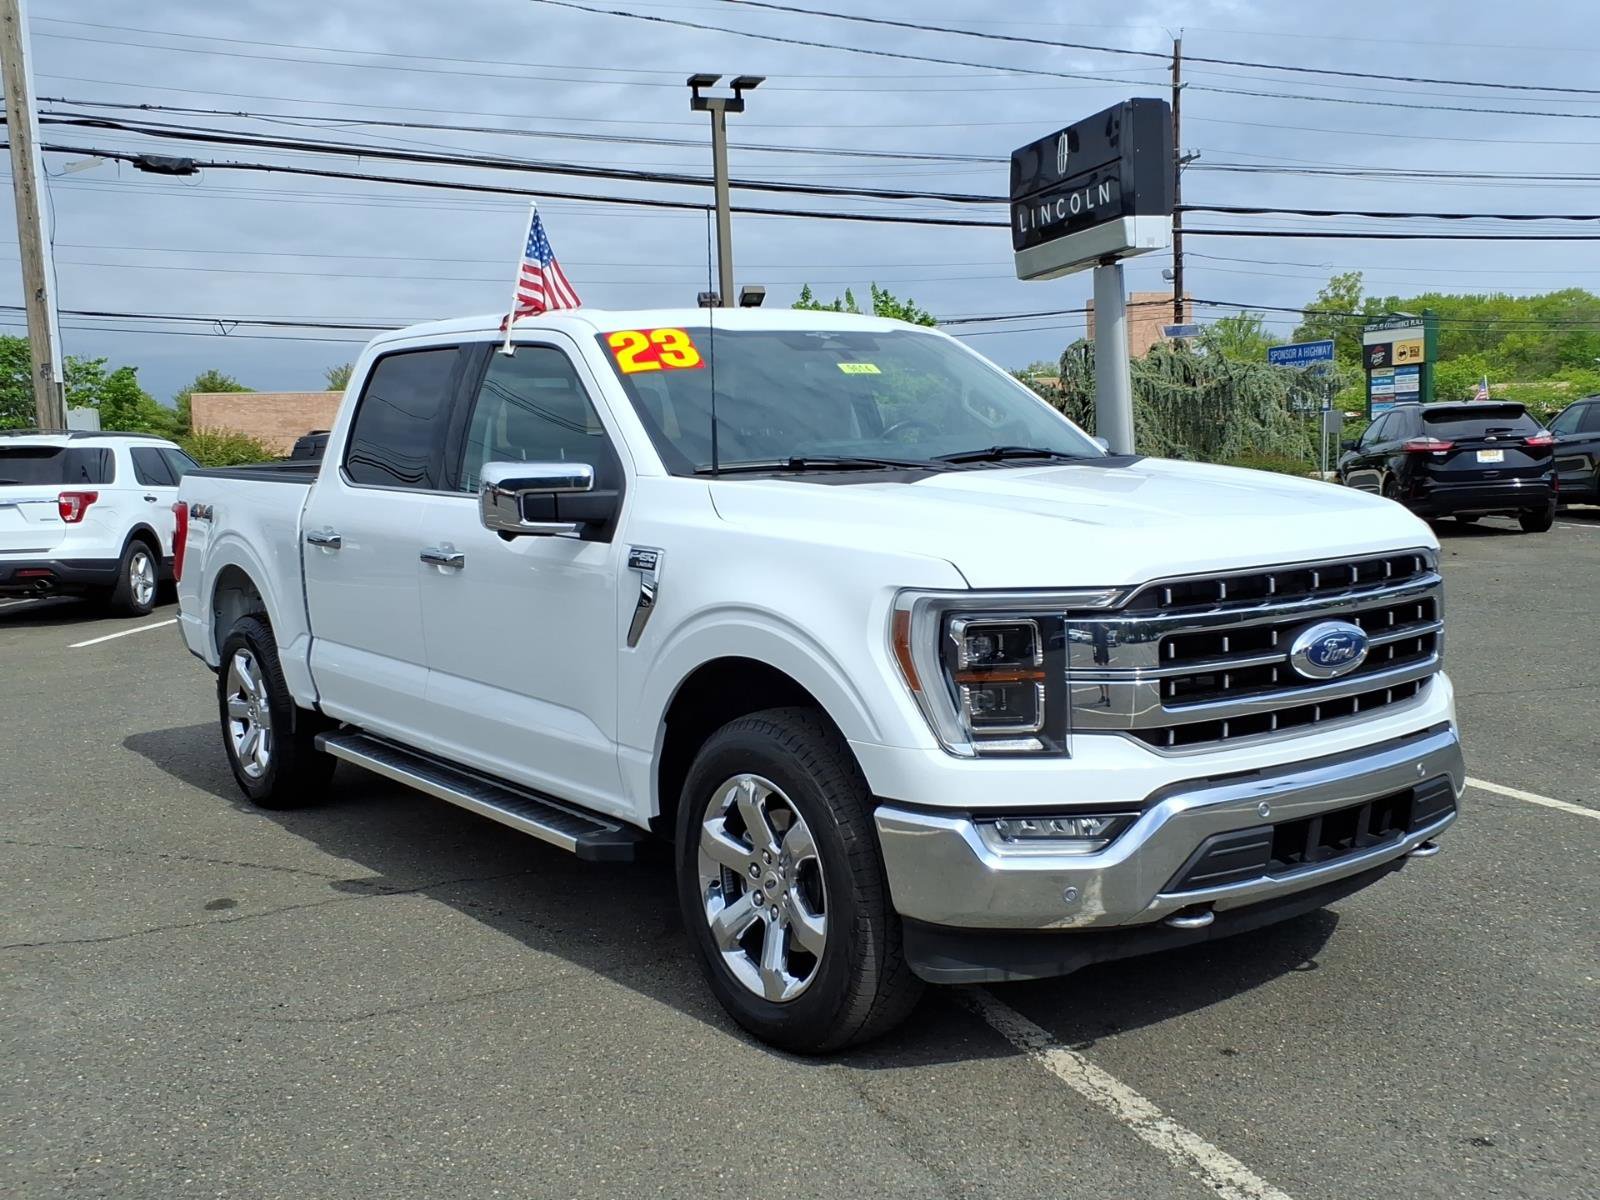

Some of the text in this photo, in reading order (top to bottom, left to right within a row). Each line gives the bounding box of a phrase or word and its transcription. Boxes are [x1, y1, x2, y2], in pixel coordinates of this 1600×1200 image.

[1019, 182, 1110, 232] LINCOLN
[608, 328, 700, 374] 23
[1270, 344, 1331, 360] SPONSOR A HIGHWAY
[1321, 637, 1356, 662] Ford
